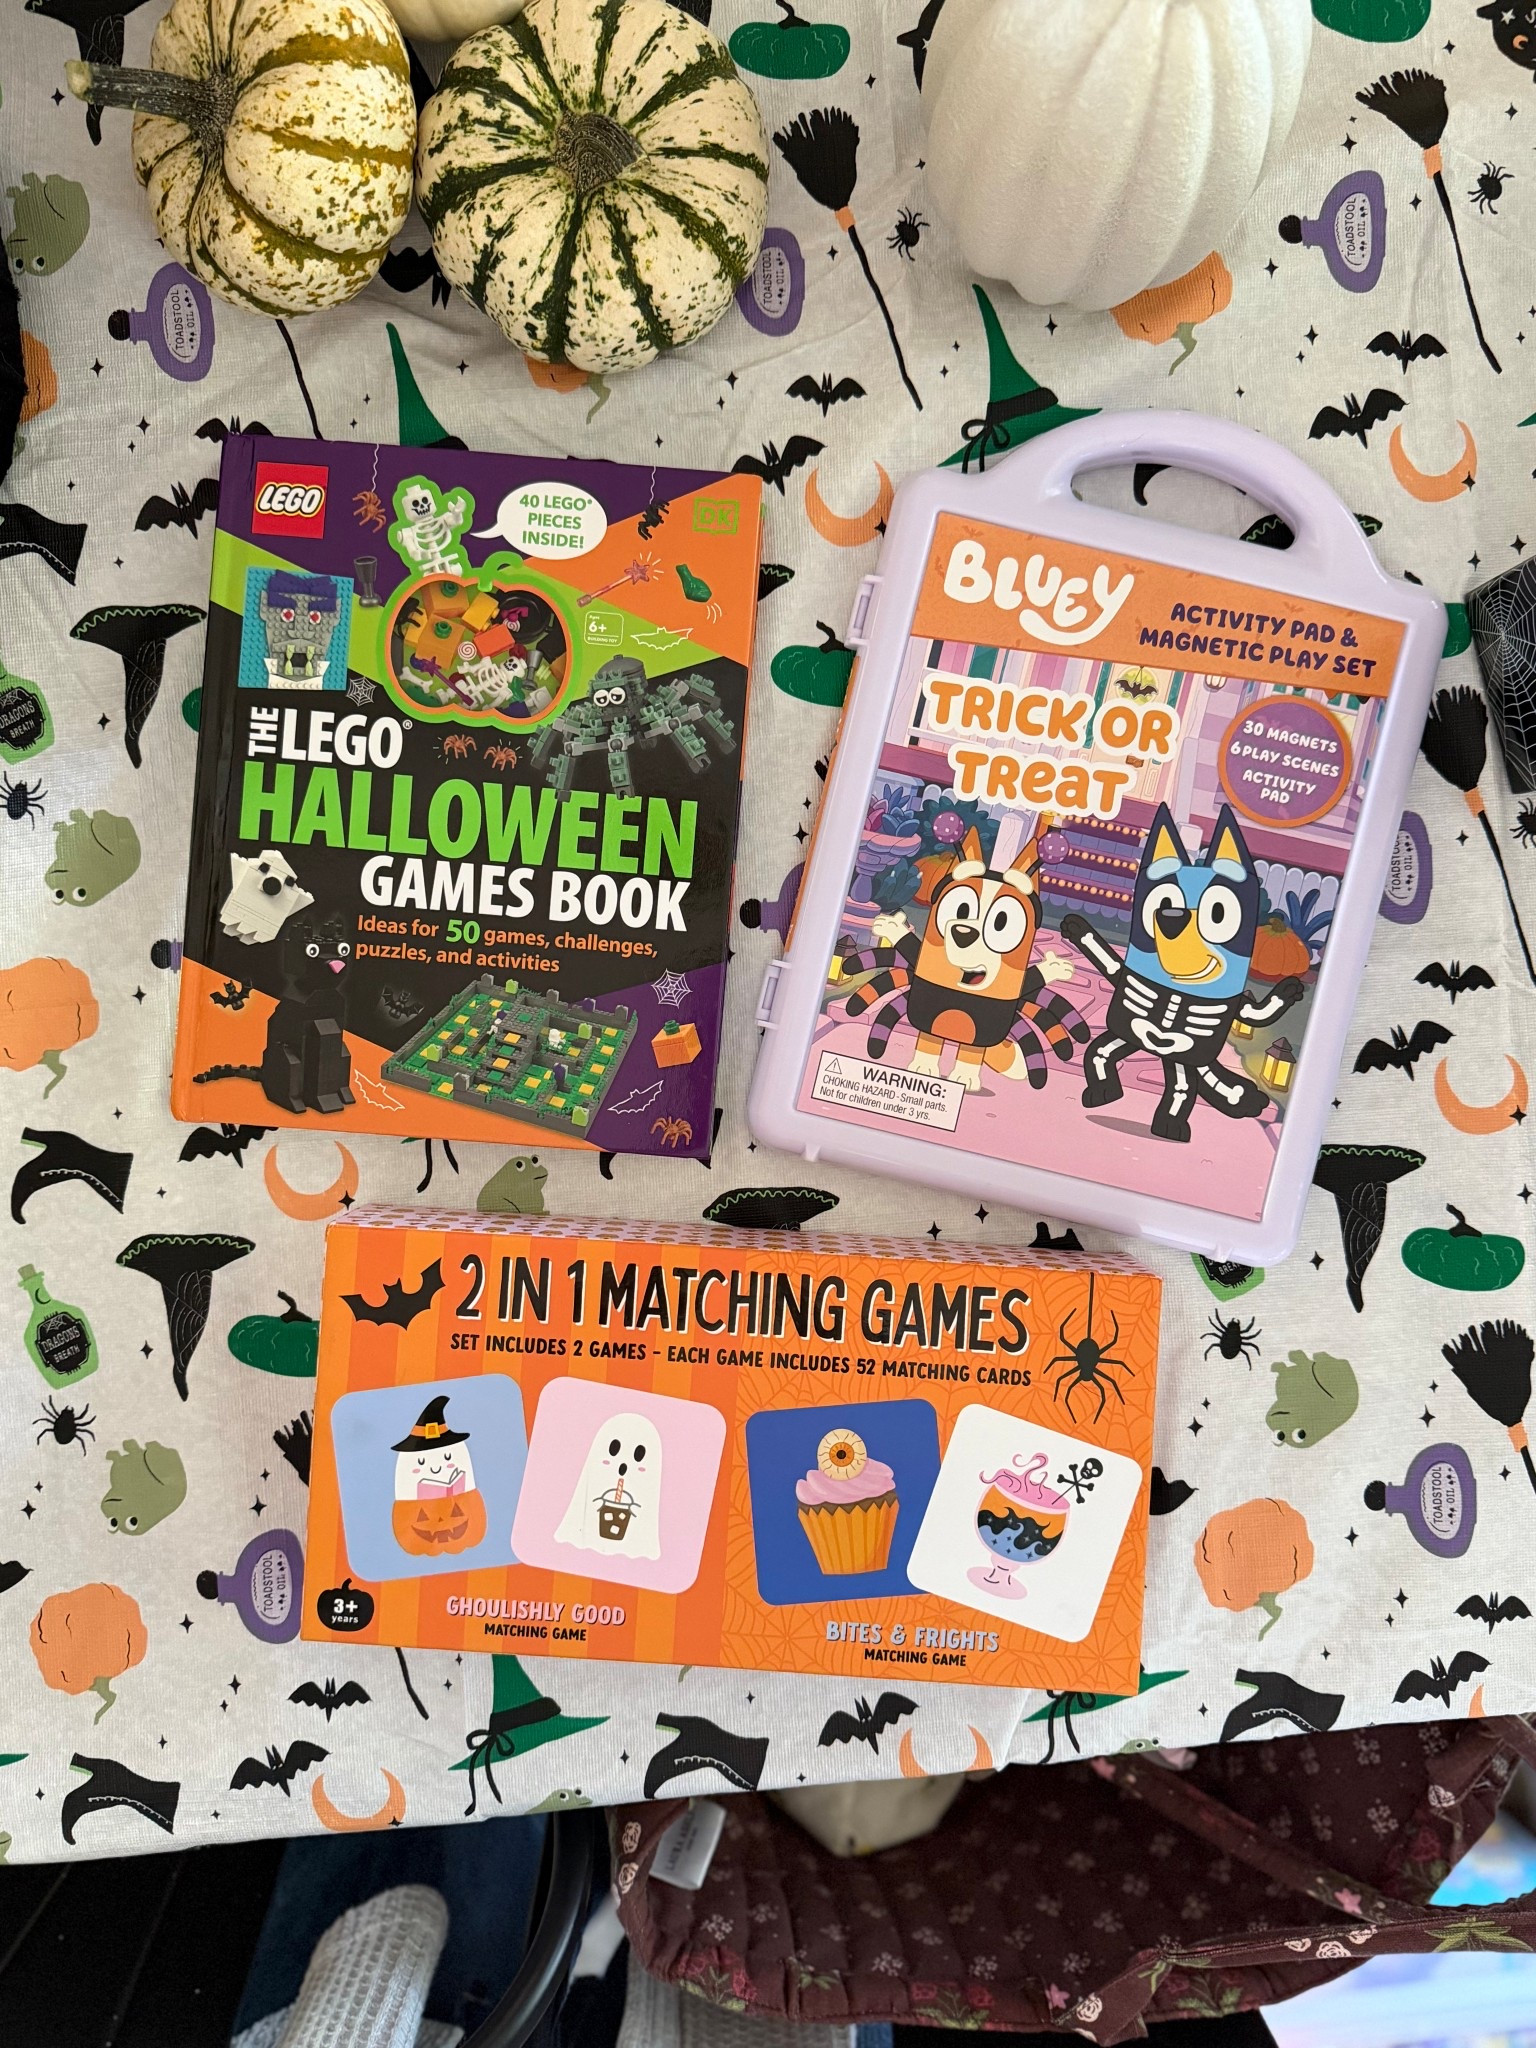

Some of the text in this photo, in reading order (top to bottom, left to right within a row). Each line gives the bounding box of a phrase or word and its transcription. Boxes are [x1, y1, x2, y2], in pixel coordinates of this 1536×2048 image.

[1344, 198, 1356, 257] TOADSTOOL
[1358, 221, 1366, 237] OIL
[762, 251, 772, 305] TOADSTOOL
[776, 268, 785, 285] OIL
[171, 289, 184, 351] TOADSTOOL
[187, 311, 195, 328] OIL
[256, 483, 325, 516] LEGO
[519, 494, 540, 508] 40
[527, 512, 582, 530] PIECES
[700, 507, 733, 527] DK
[522, 530, 585, 549] INSIDE!
[943, 539, 1135, 646] BLUEY
[589, 621, 607, 633] 6+
[1170, 602, 1359, 648] ACTIVITY PAD &
[1139, 627, 1378, 679] MAGNETIC PLAY SET
[9, 719, 35, 739] BREATH
[248, 706, 280, 758] THE
[930, 680, 1174, 756] TRICK OR
[1243, 720, 1338, 754] 30 MAGNETS
[1230, 741, 1340, 778] 6 PLAY SCENES
[1242, 769, 1317, 795] ACTIVITY
[1260, 787, 1290, 804] PAD
[239, 761, 698, 879] HALLOWEEN
[1404, 855, 1413, 871] OIL
[359, 854, 692, 932] GAMES BOOK
[357, 914, 658, 958] Ideas for 50 games, challenges,
[355, 941, 561, 973] puzzles, and activities
[822, 1074, 860, 1092] CHOKING
[925, 1097, 948, 1113] parts.
[863, 1066, 947, 1099] WARNING:
[820, 1085, 931, 1121] Not for children under 3 yrs.
[455, 1254, 1032, 1357] 2 IN 1 MATCHING GAMES
[41, 1325, 80, 1353] DRAGONS
[53, 1344, 81, 1363] BREATH
[450, 1333, 480, 1350] SET
[485, 1335, 567, 1355] INCLUDES
[573, 1340, 583, 1357] 2
[589, 1341, 647, 1360] GAMES
[667, 1345, 710, 1364] EACH
[716, 1348, 764, 1367] GAME
[770, 1352, 850, 1373] INCLUDES
[856, 1358, 876, 1375] 52
[882, 1359, 970, 1382] MATCHING
[976, 1366, 1032, 1386] CARDS
[1432, 1467, 1443, 1524] TOADSTOOL
[1446, 1487, 1455, 1504] OIL
[262, 1554, 273, 1612] TOADSTOOL
[277, 1573, 286, 1590] OIL
[331, 1614, 359, 1624] years
[333, 1598, 358, 1613] 3+
[446, 1595, 627, 1626] GHOULISHLY GOOD
[484, 1622, 587, 1641] MATCHING GAME
[826, 1620, 1000, 1653] BITES & FRIGHTS
[864, 1648, 967, 1667] MATCHING GAME
